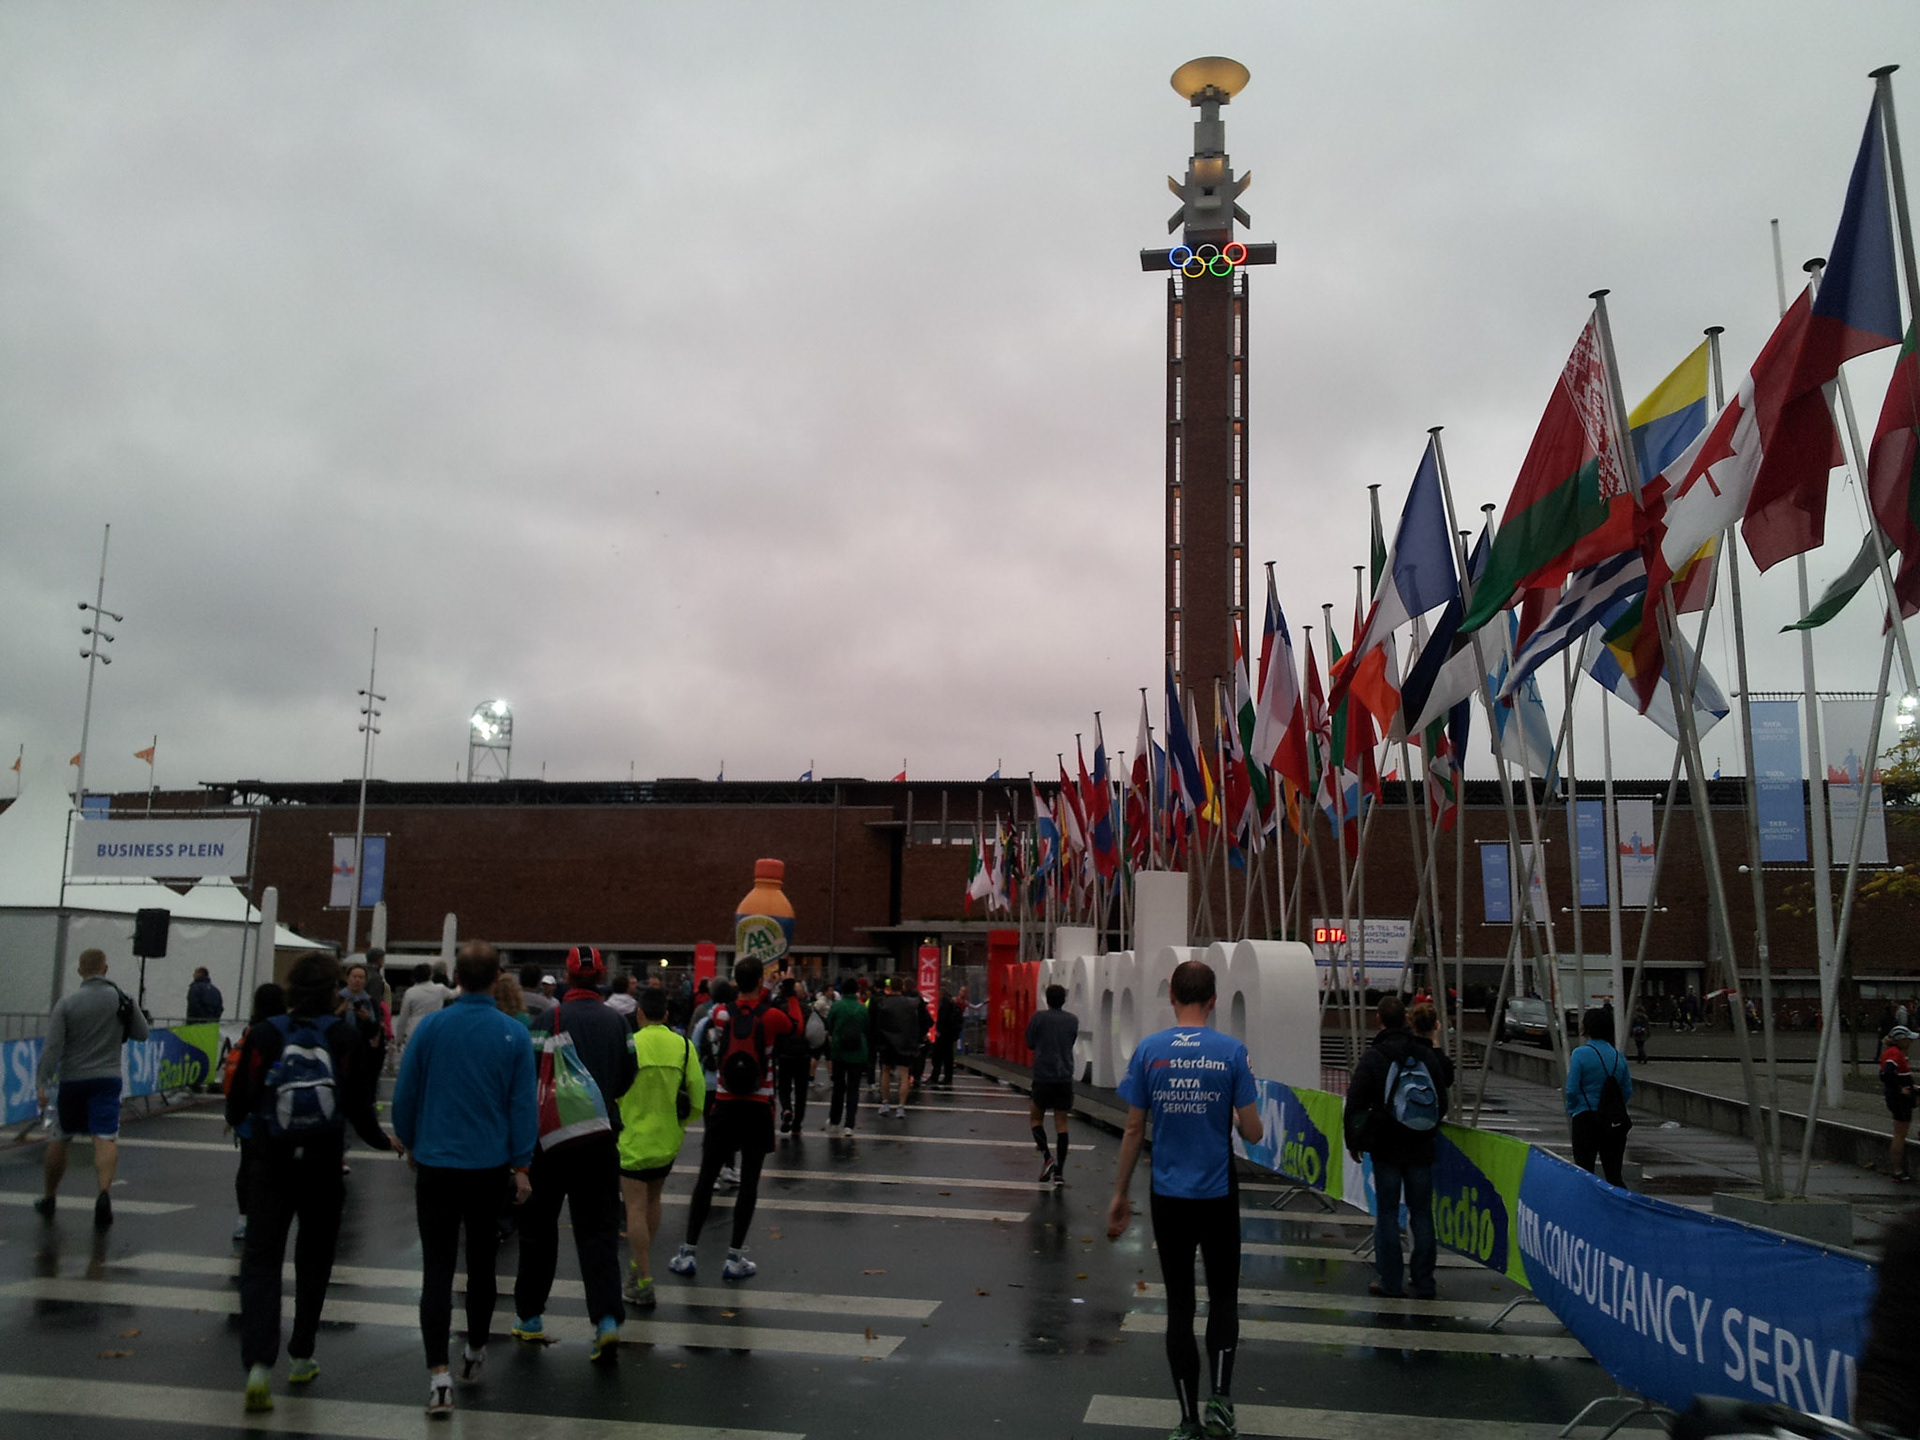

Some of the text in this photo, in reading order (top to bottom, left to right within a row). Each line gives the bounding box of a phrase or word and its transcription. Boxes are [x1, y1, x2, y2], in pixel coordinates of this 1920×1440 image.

[97, 843, 224, 857] BUSINESS PLEIN
[747, 930, 772, 954] AA
[1168, 1078, 1200, 1088] TATA
[1153, 1090, 1222, 1102] CONSULTANCY
[1162, 1103, 1207, 1114] SERVICES
[1432, 1185, 1495, 1262] adio
[1543, 1221, 1712, 1364] CONSULTANCY
